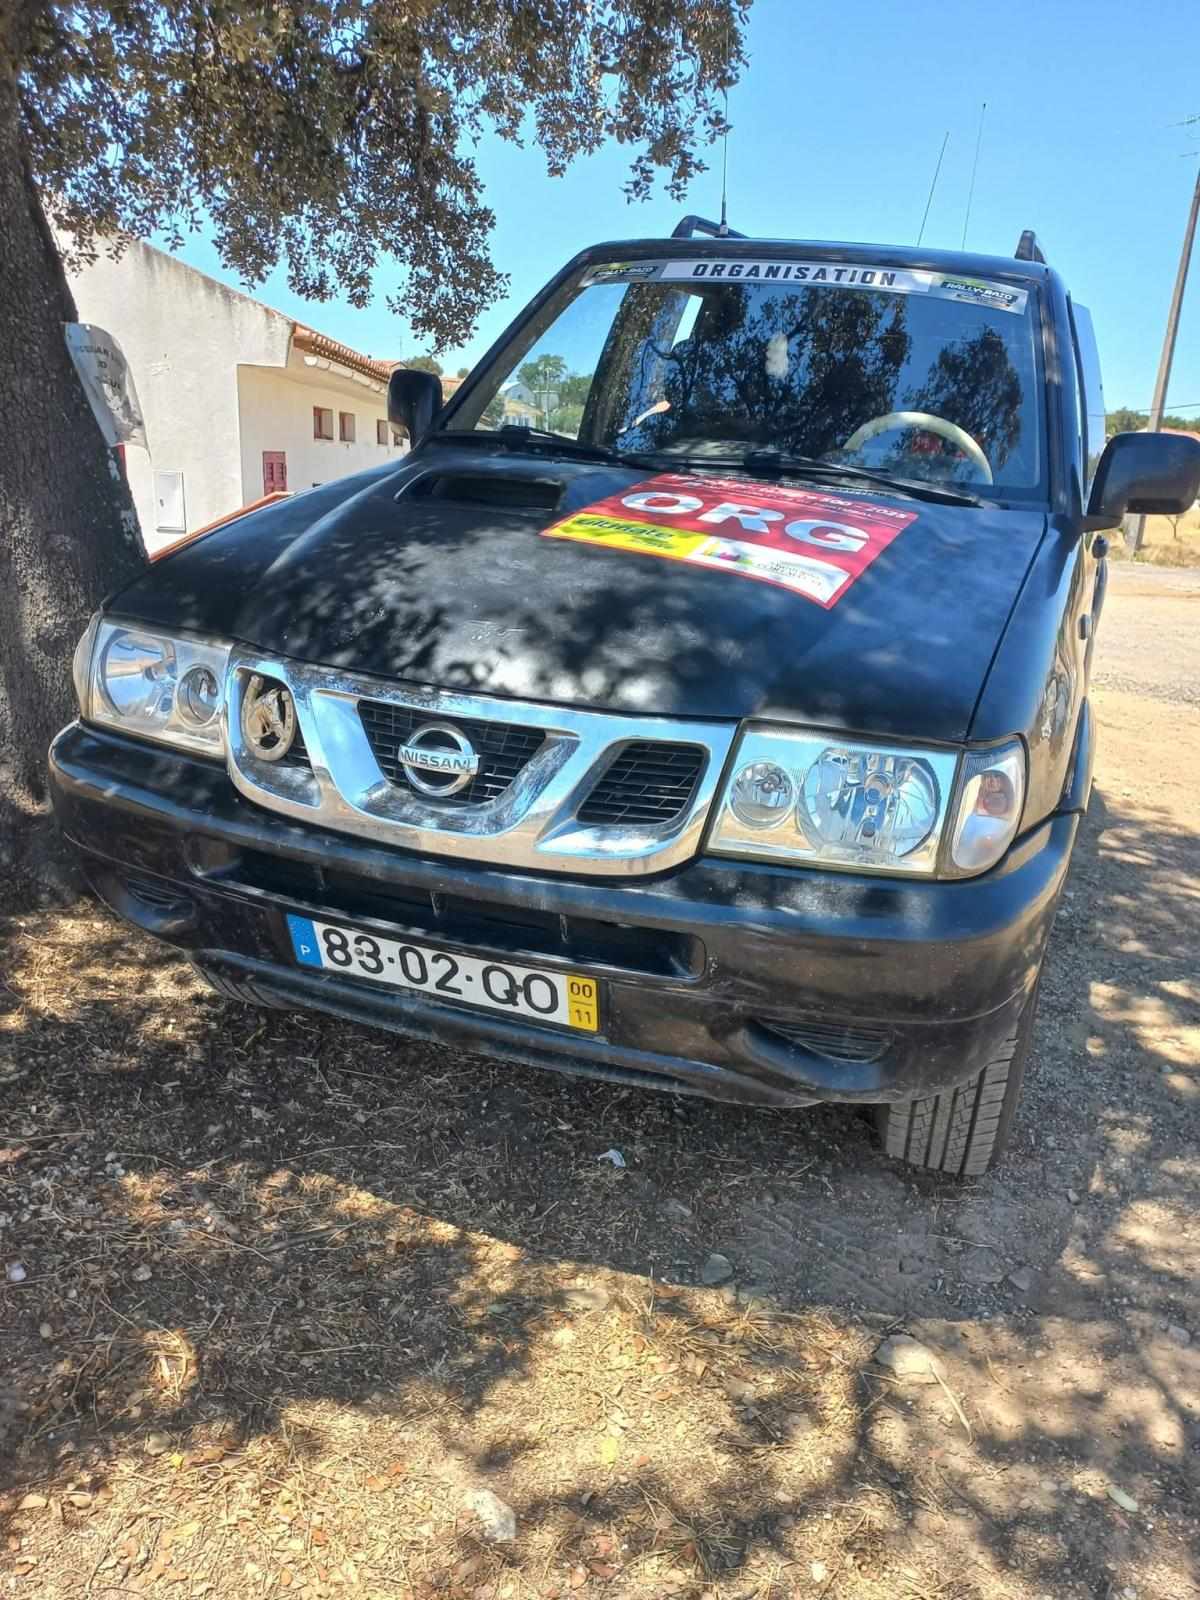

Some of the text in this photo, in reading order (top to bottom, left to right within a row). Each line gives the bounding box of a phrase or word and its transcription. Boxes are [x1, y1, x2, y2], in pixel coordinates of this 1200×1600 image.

[691, 262, 897, 288] ORGANISATION
[620, 491, 871, 553] ORG
[403, 748, 471, 770] NISSAN
[300, 944, 311, 956] P
[569, 981, 594, 999] 00
[574, 1008, 593, 1025] 11
